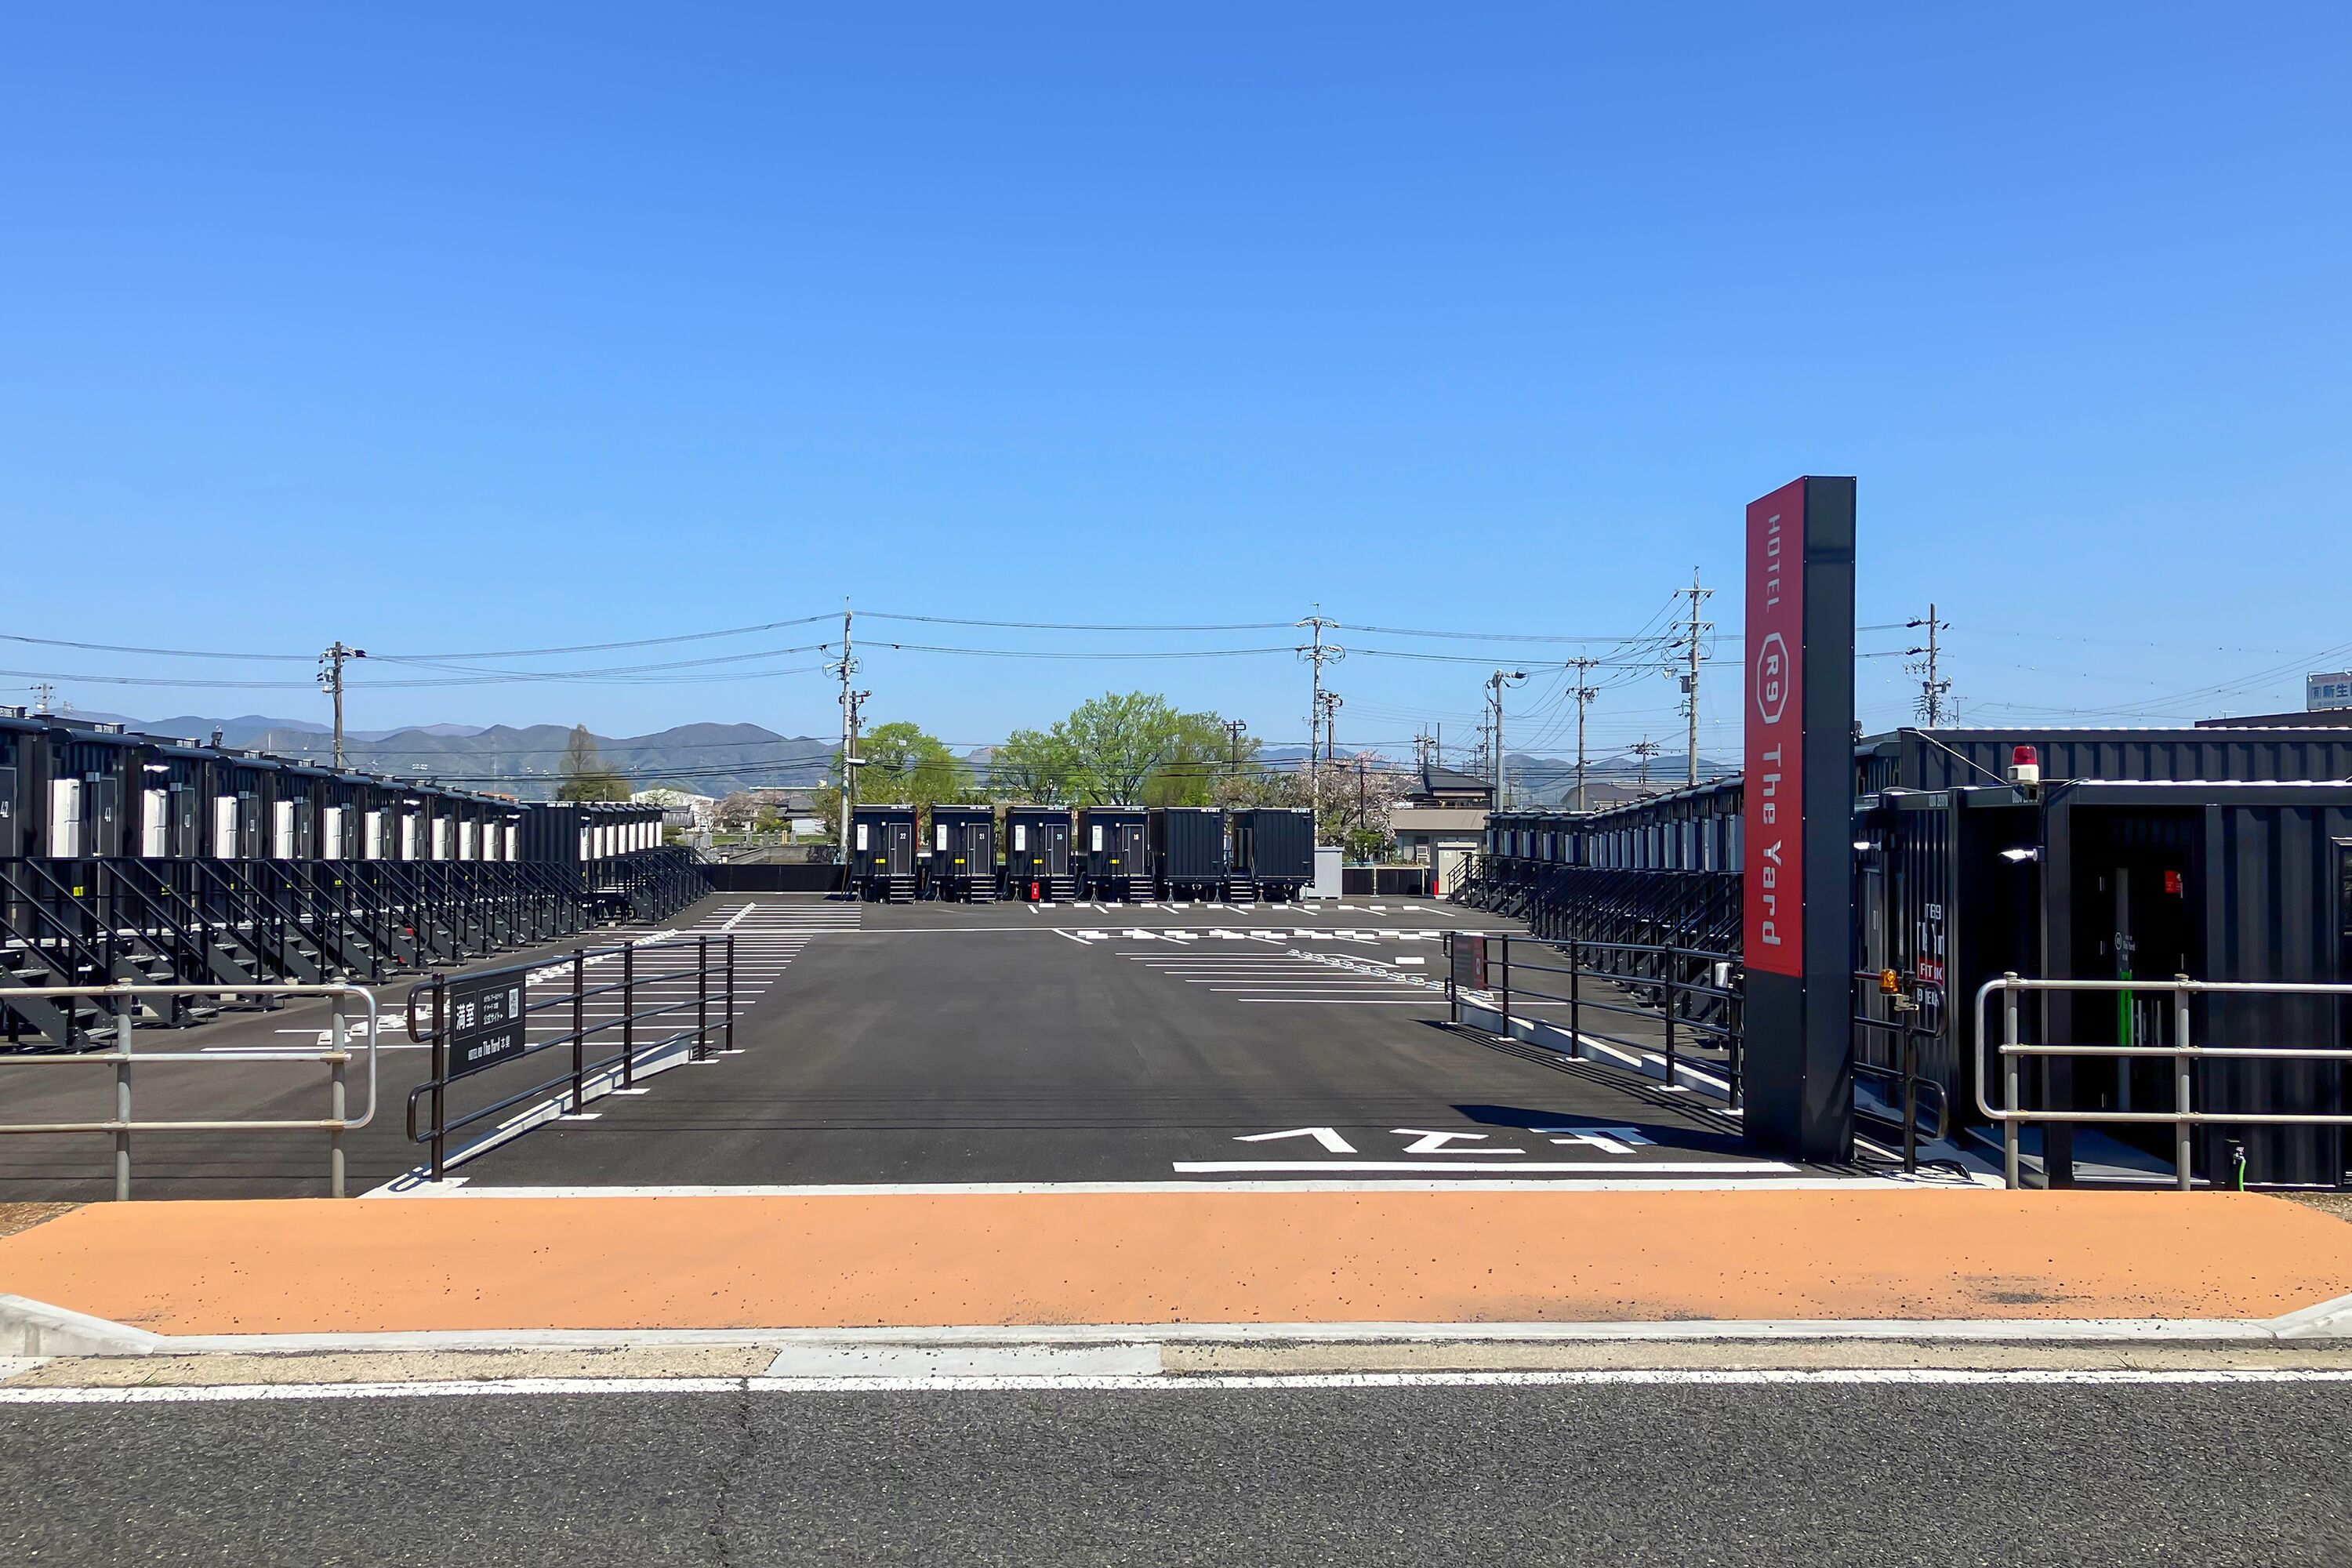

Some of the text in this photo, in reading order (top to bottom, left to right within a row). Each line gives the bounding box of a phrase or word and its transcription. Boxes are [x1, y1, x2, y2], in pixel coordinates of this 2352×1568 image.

[1762, 514, 1782, 946] HOTEL R9 The Yard
[0, 800, 9, 818] 42
[104, 807, 111, 822] 41
[456, 1002, 475, 1030] 満室
[491, 1036, 500, 1054] Yard
